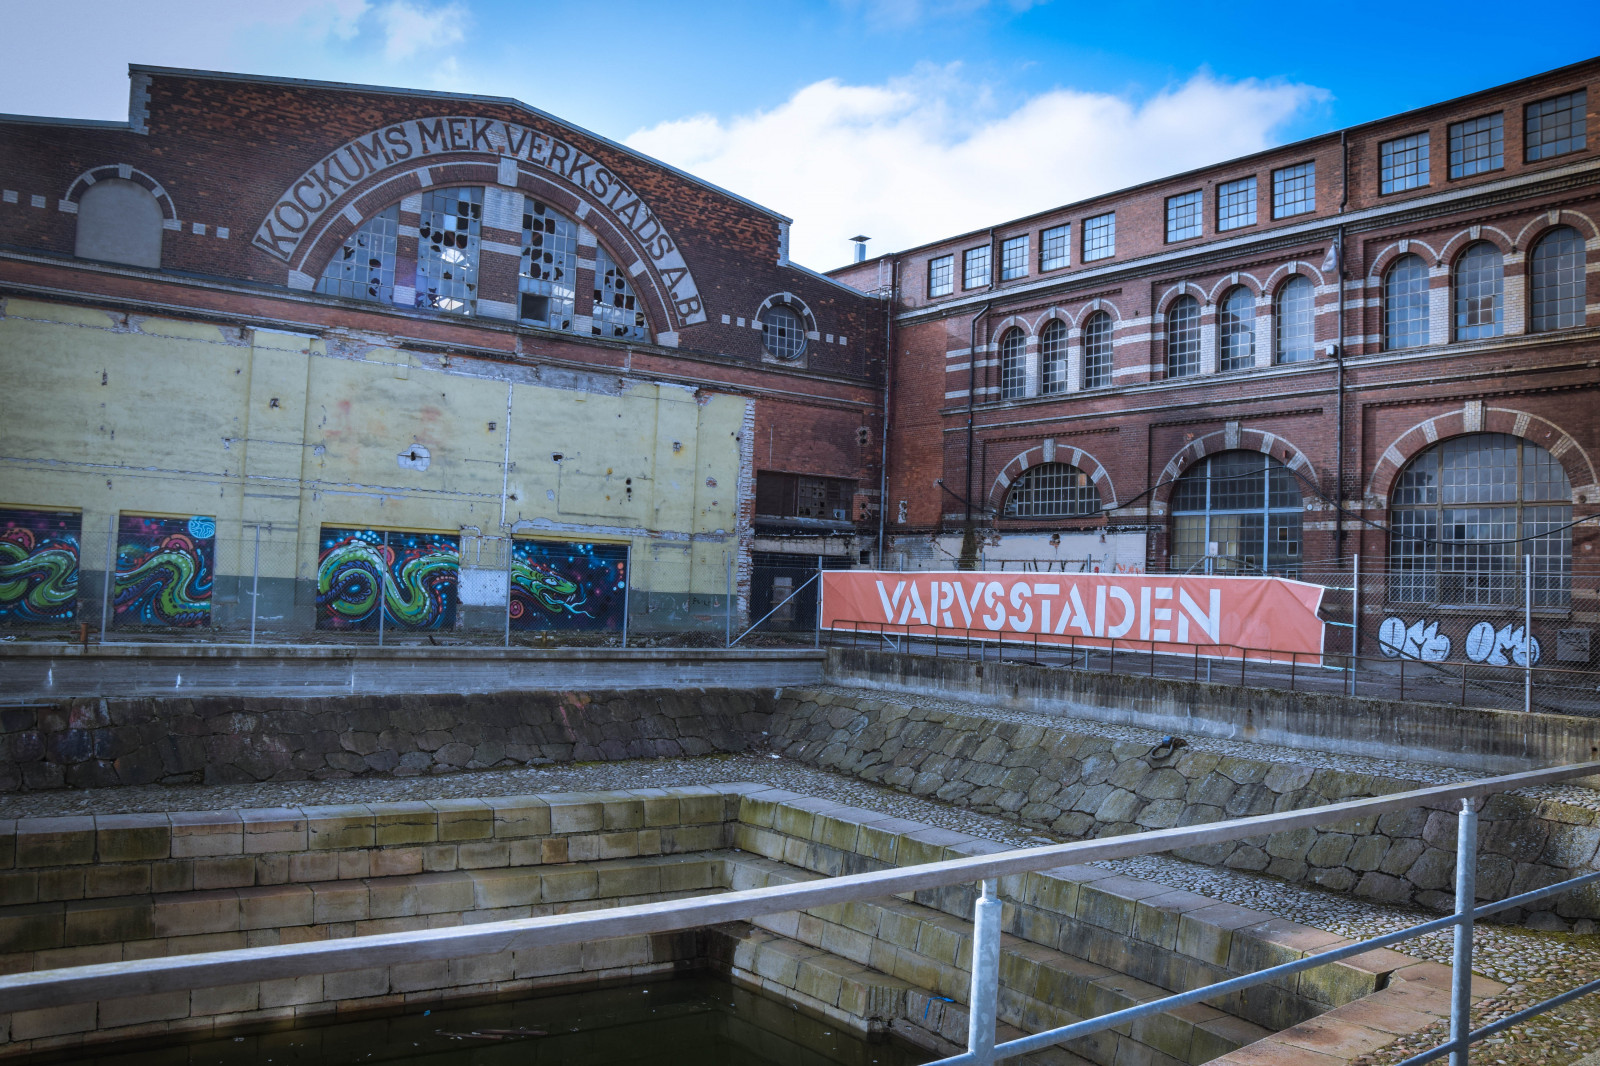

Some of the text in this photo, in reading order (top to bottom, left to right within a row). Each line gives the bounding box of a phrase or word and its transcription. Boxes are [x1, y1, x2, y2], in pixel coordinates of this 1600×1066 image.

[254, 121, 413, 260] KOCKUMS
[503, 123, 676, 261] VERKSTADS
[875, 580, 1221, 644] VARVSSTADEN
